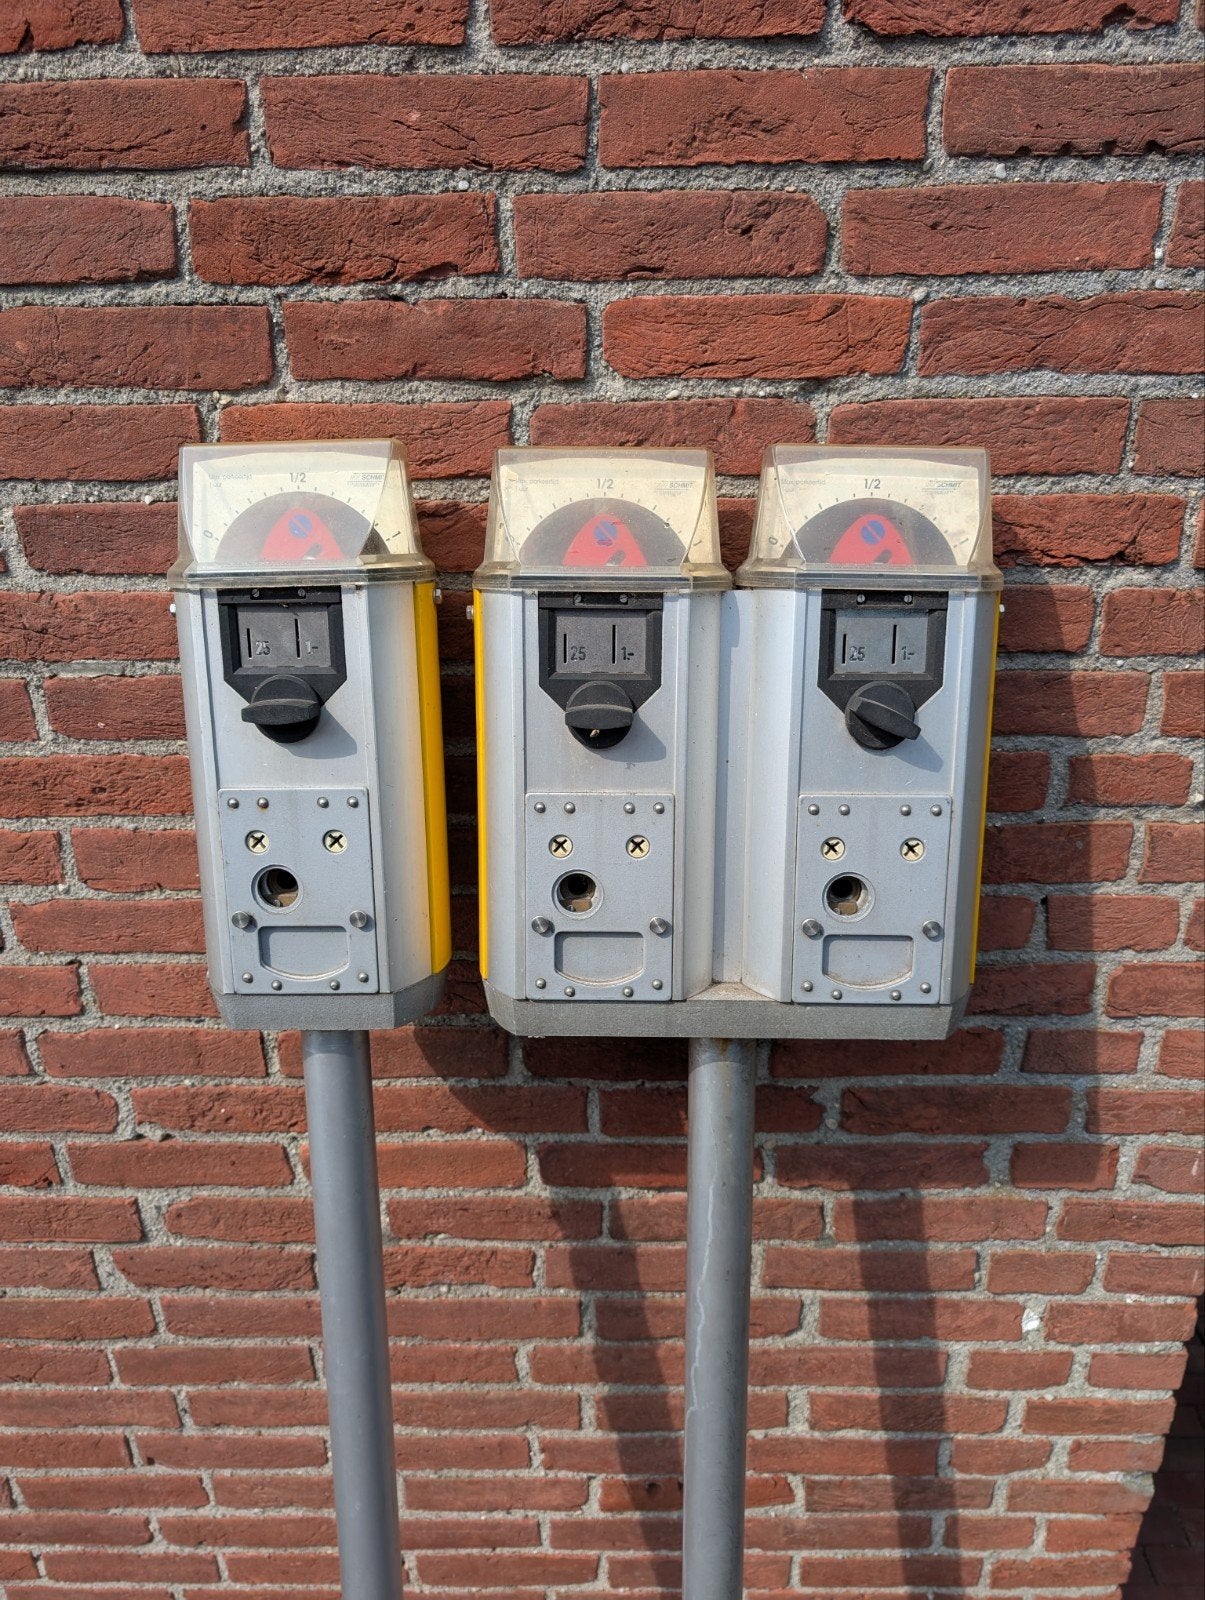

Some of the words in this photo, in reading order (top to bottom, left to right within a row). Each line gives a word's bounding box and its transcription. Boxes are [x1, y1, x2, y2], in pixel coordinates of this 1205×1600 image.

[290, 472, 307, 483] 1/2
[597, 478, 614, 489] 1/2
[864, 478, 881, 489] 1/2
[203, 530, 213, 539] 0
[768, 536, 779, 546] 0
[255, 640, 271, 656] 25
[570, 645, 587, 661] 25
[848, 645, 866, 662] 25
